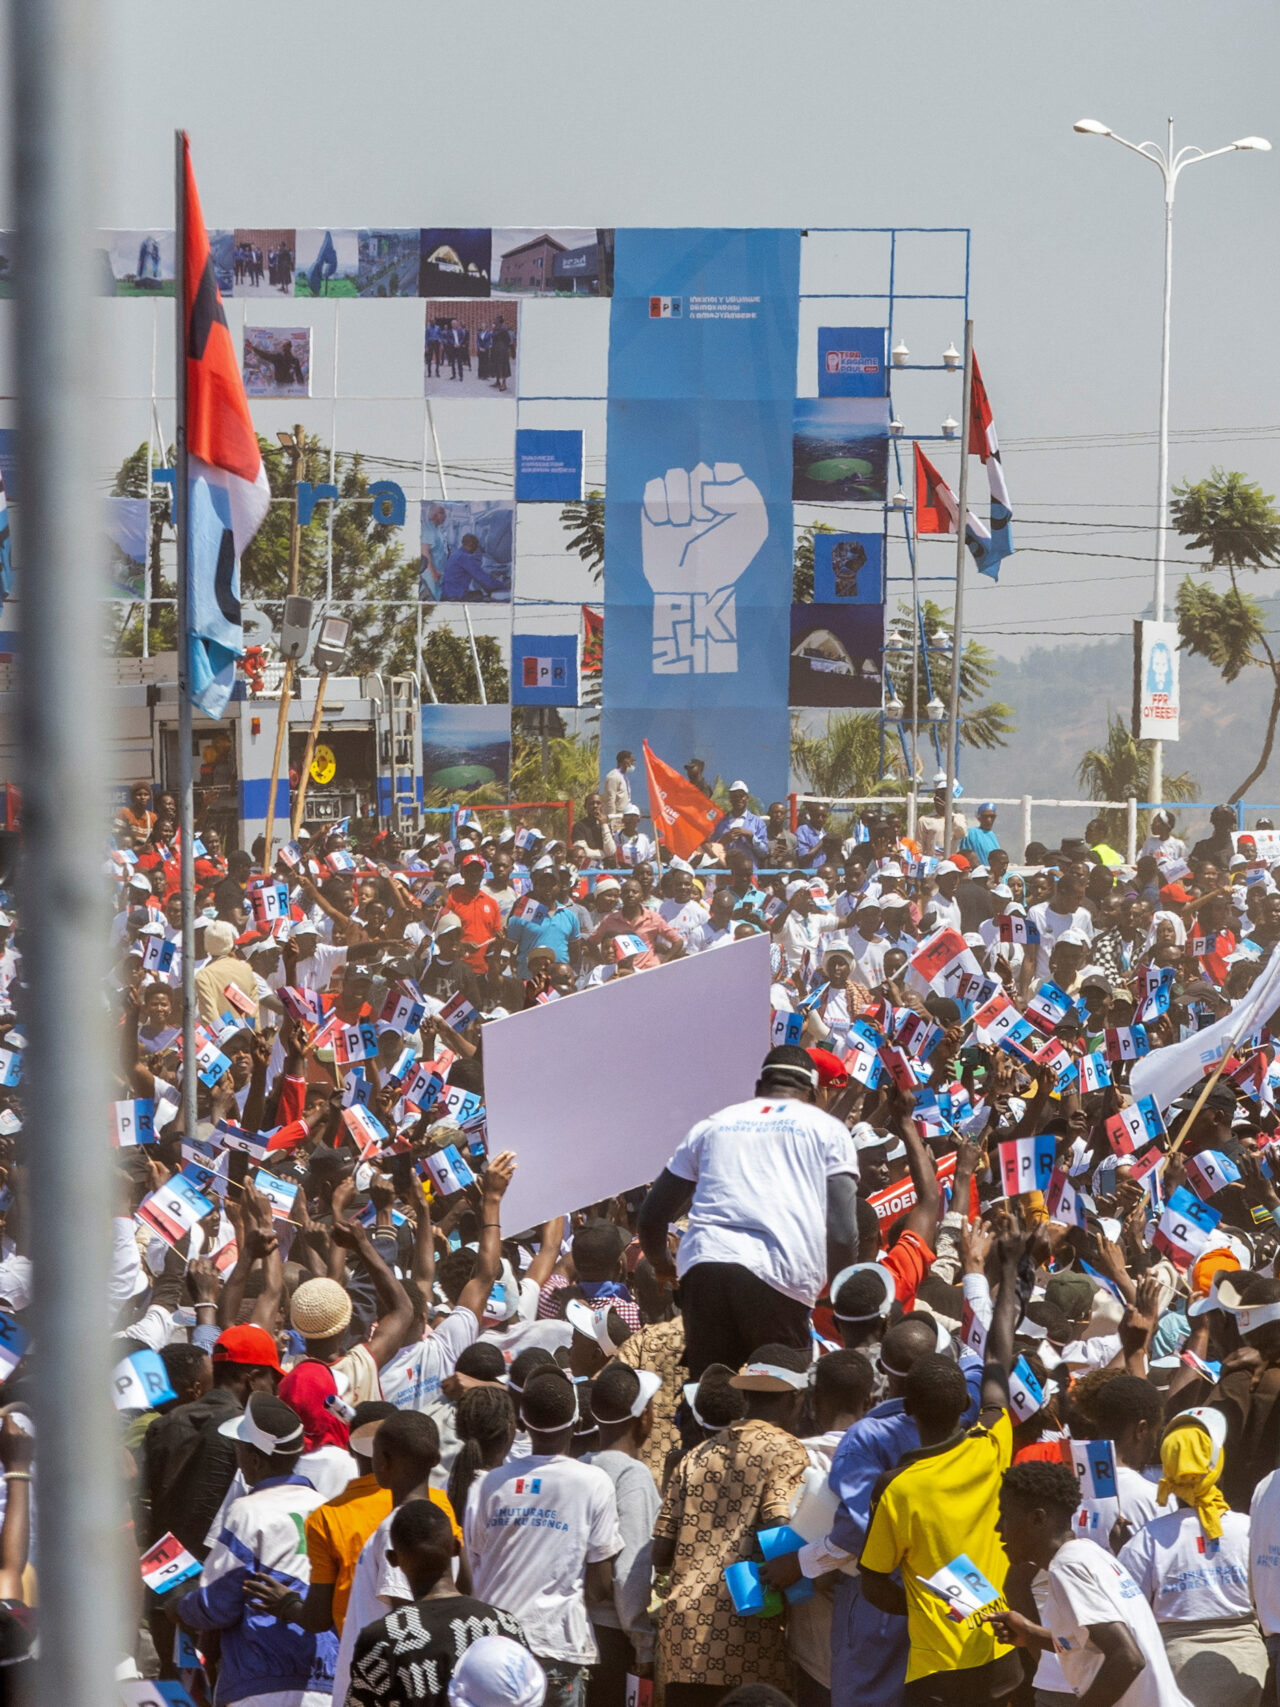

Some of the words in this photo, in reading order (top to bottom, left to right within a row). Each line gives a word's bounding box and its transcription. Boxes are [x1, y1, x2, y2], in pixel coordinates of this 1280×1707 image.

[1152, 693, 1169, 705] FPR
[252, 888, 288, 915] FPR
[1001, 924, 1038, 938] FPR
[335, 1029, 376, 1055] FPR
[1109, 1036, 1145, 1053] FPR
[1112, 1109, 1156, 1145] FPR
[437, 1159, 466, 1184] PR
[1005, 1153, 1053, 1181] FPR
[874, 1191, 919, 1219] BIOEN
[114, 1372, 163, 1395] PR
[1012, 1372, 1037, 1409] PR
